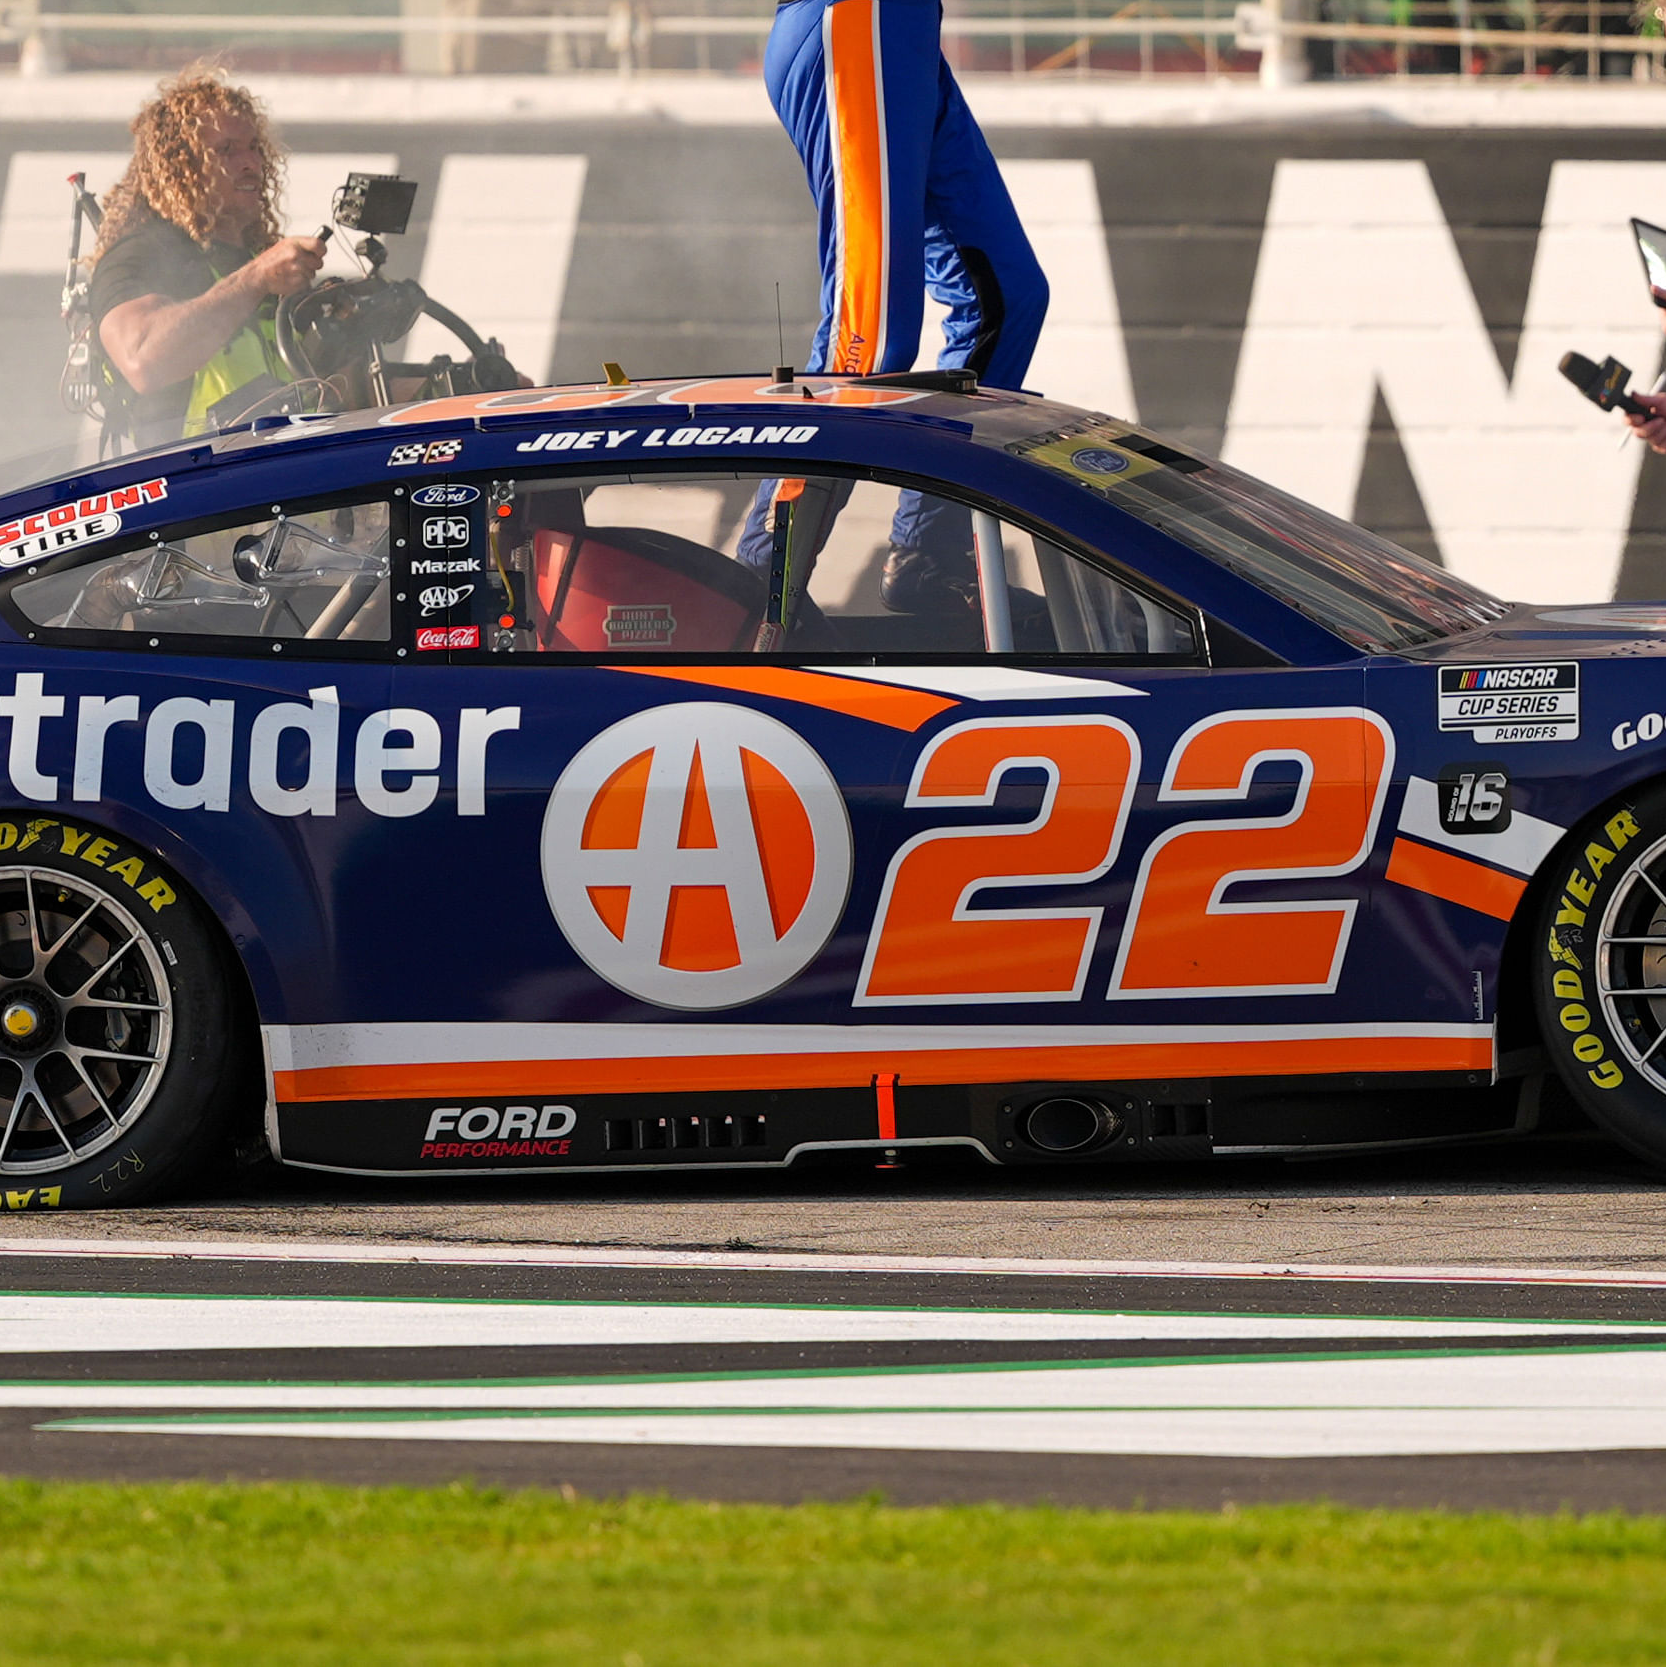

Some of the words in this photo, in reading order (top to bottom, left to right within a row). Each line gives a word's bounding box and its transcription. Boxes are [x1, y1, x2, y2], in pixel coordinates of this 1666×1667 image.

[516, 428, 637, 453] JOEY
[642, 425, 820, 448] LOGANO
[423, 486, 468, 504] Ford
[11, 517, 107, 560] TIRE
[425, 518, 468, 546] PPG
[410, 557, 482, 575] Mazak
[423, 587, 459, 608] AAA
[621, 610, 656, 621] HUNT
[1482, 667, 1559, 689] NASCAR
[1458, 698, 1495, 716] CUP
[1496, 695, 1559, 714] SERIES
[1494, 726, 1558, 740] PLAYOFFS
[1453, 772, 1508, 823] 16
[851, 705, 1396, 1009] 22
[424, 1104, 577, 1141] FORD
[420, 1139, 573, 1159] PERFORMANCE
